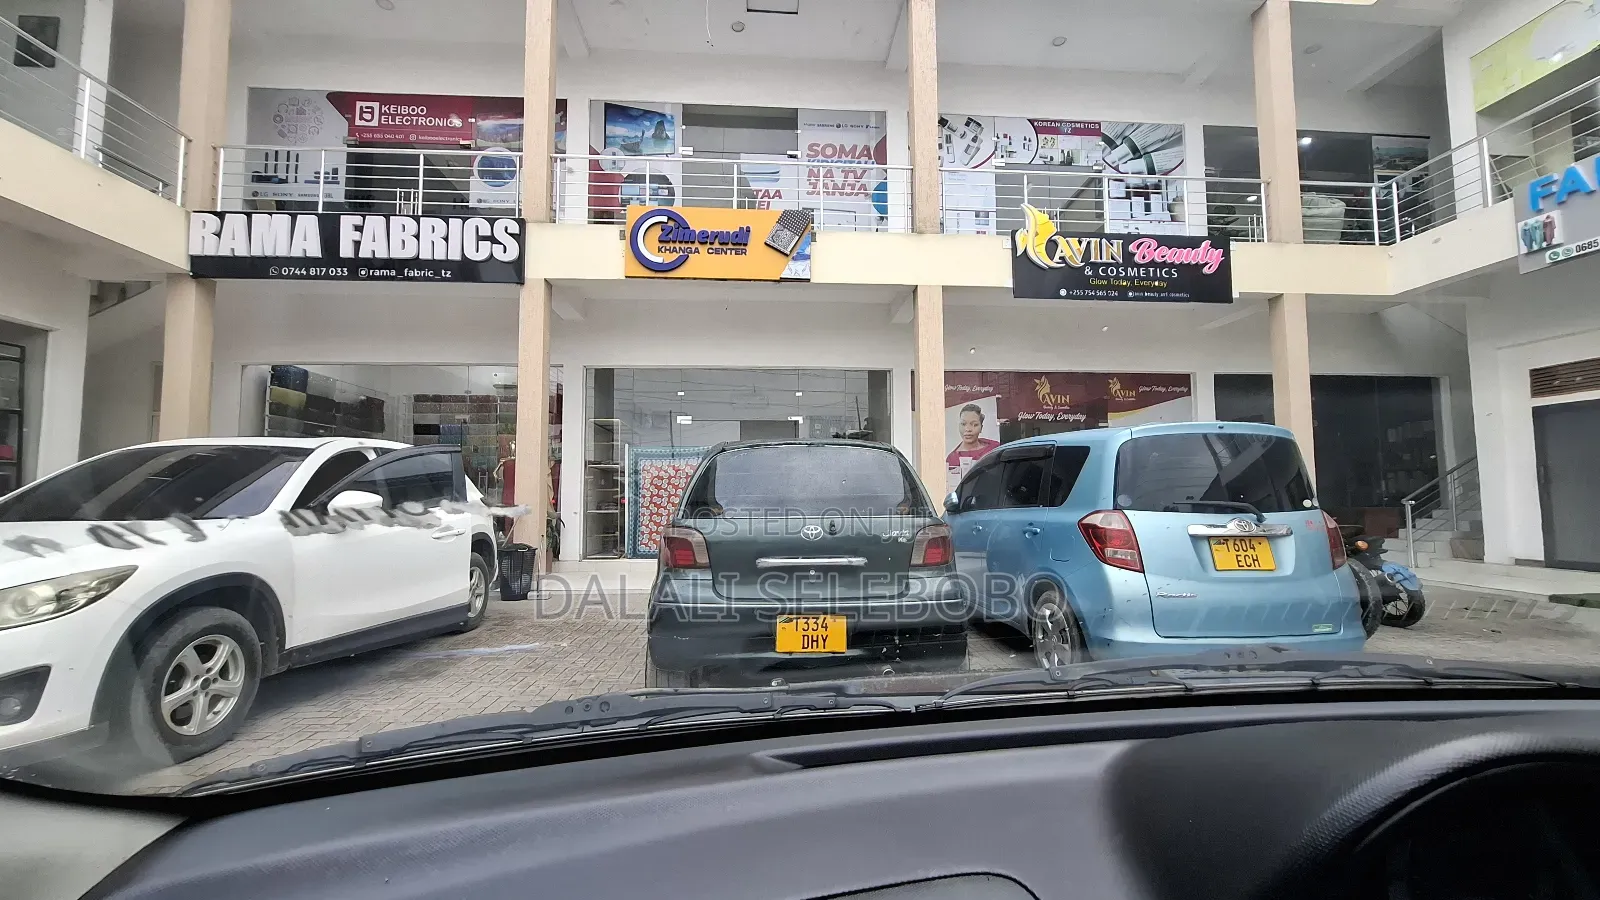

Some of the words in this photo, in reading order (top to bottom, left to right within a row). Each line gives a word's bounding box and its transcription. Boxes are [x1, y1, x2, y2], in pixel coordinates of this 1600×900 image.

[381, 104, 427, 115] KEIBOO
[381, 115, 463, 128] ELECTRONICS
[806, 142, 873, 160] SOMA
[806, 168, 834, 181] NA
[841, 169, 868, 182] TV
[806, 181, 870, 196] JANJA
[1529, 155, 1600, 213] FA
[189, 212, 323, 258] RAMA
[339, 214, 520, 262] FABRICS
[658, 223, 751, 246] Zimerudi
[657, 246, 700, 255] KHANGA
[707, 247, 747, 256] CENTER
[1575, 238, 1600, 254] 0685
[1128, 237, 1225, 275] Beauty
[281, 267, 307, 276] 0744
[309, 267, 326, 276] 817
[328, 267, 349, 276] 033
[1084, 265, 1093, 276] &
[1099, 266, 1178, 278] COSMETICS
[1134, 279, 1167, 288] Everyday
[972, 384, 994, 393] Everyday
[1167, 385, 1188, 393] Everyday
[1018, 411, 1035, 421] Glow
[1035, 411, 1056, 422] Today,
[1056, 411, 1087, 422] Everyday
[1235, 553, 1261, 568] ECH
[801, 634, 829, 650] DHY
